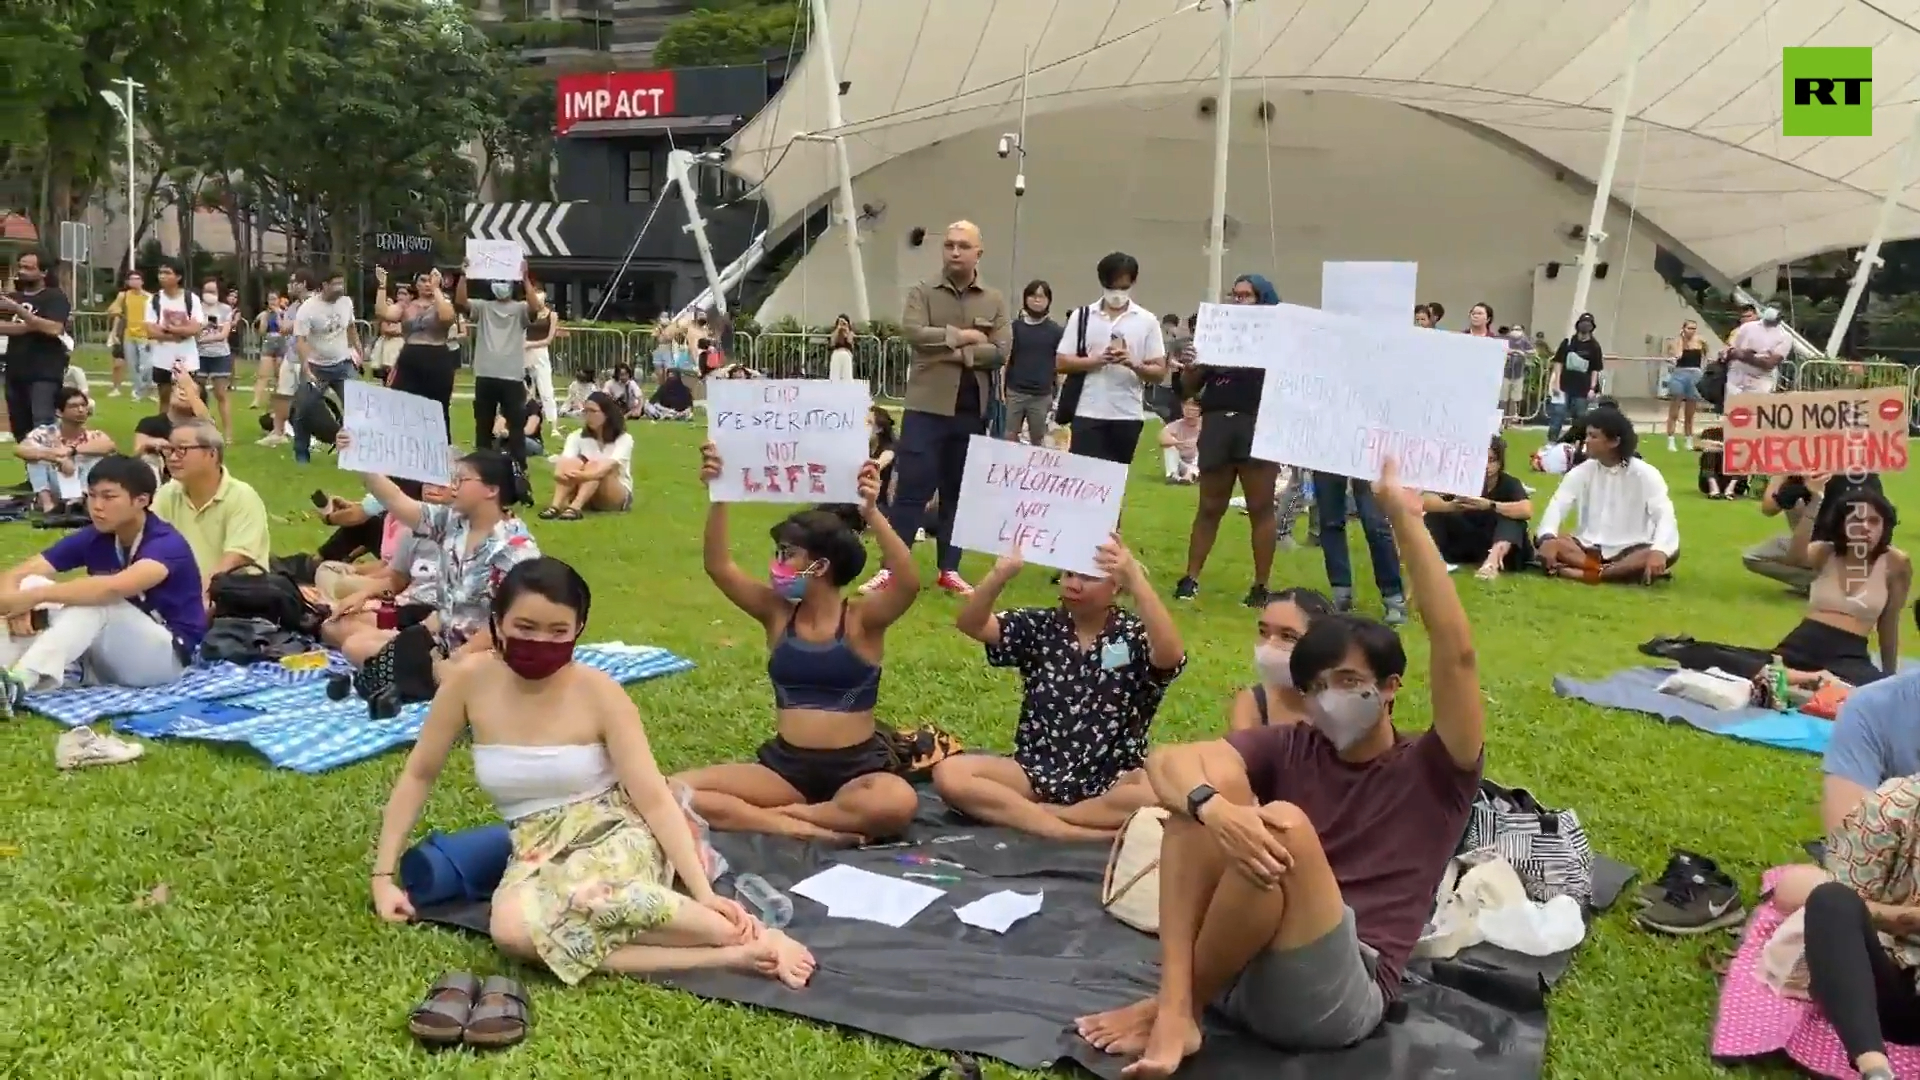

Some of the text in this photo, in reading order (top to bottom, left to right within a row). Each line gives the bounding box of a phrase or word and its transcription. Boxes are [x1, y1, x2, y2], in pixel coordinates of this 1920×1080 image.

[564, 88, 664, 119] IMPACT
[1756, 399, 1870, 430] NO MORE
[766, 441, 798, 461] NOT
[1724, 430, 1908, 474] EXECUTIONS
[741, 461, 827, 494] LIFE
[986, 463, 1112, 504] EXPLOITATION
[1015, 500, 1050, 519] NOT
[998, 519, 1062, 554] LIFE!
